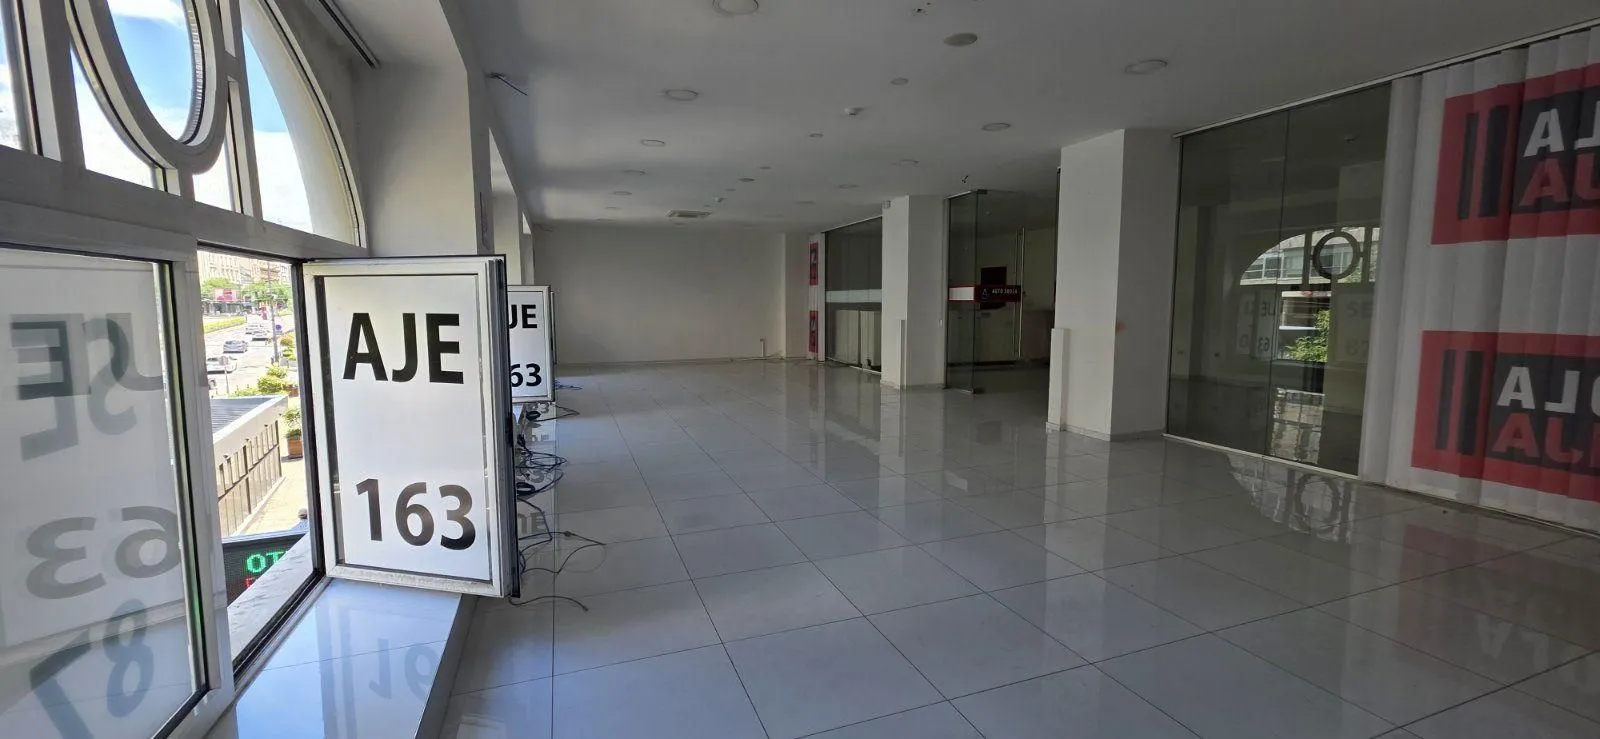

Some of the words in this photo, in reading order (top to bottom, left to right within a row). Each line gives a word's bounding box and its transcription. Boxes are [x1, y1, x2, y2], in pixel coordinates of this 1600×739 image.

[508, 304, 538, 329] JE
[343, 312, 464, 385] AJE
[510, 363, 542, 388] 63
[355, 478, 476, 551] 163
